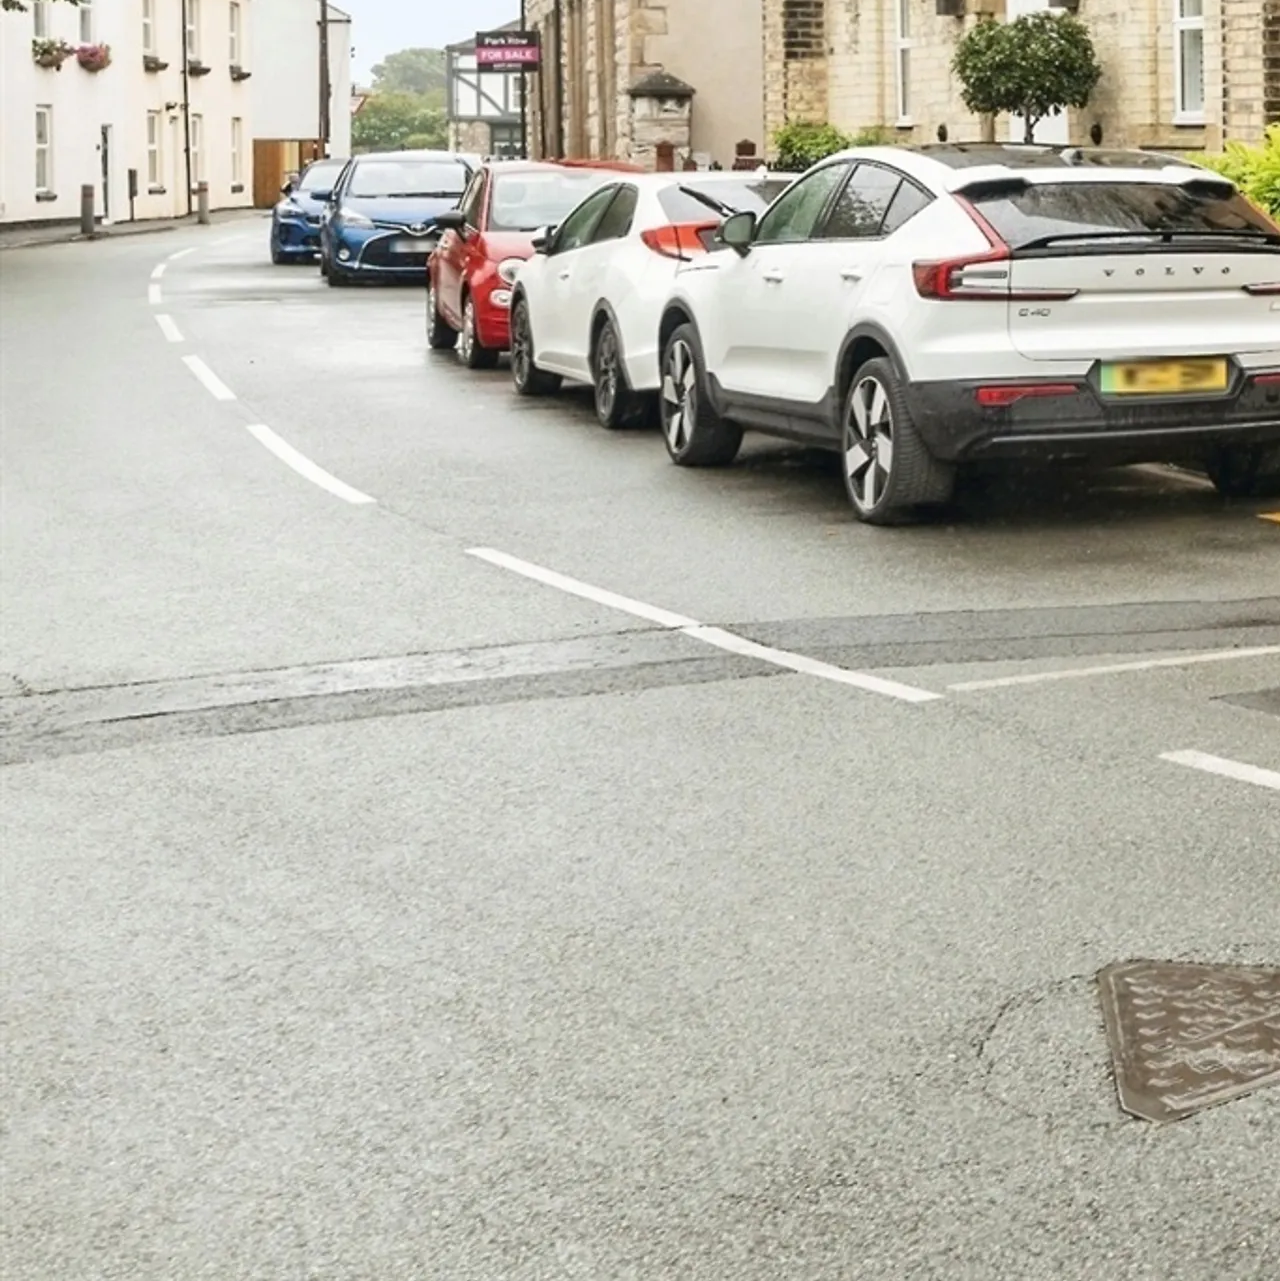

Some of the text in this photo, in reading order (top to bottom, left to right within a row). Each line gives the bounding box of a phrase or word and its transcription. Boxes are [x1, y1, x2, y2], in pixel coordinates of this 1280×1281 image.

[481, 50, 533, 61] FOR SALE
[1103, 266, 1231, 278] VOLVO
